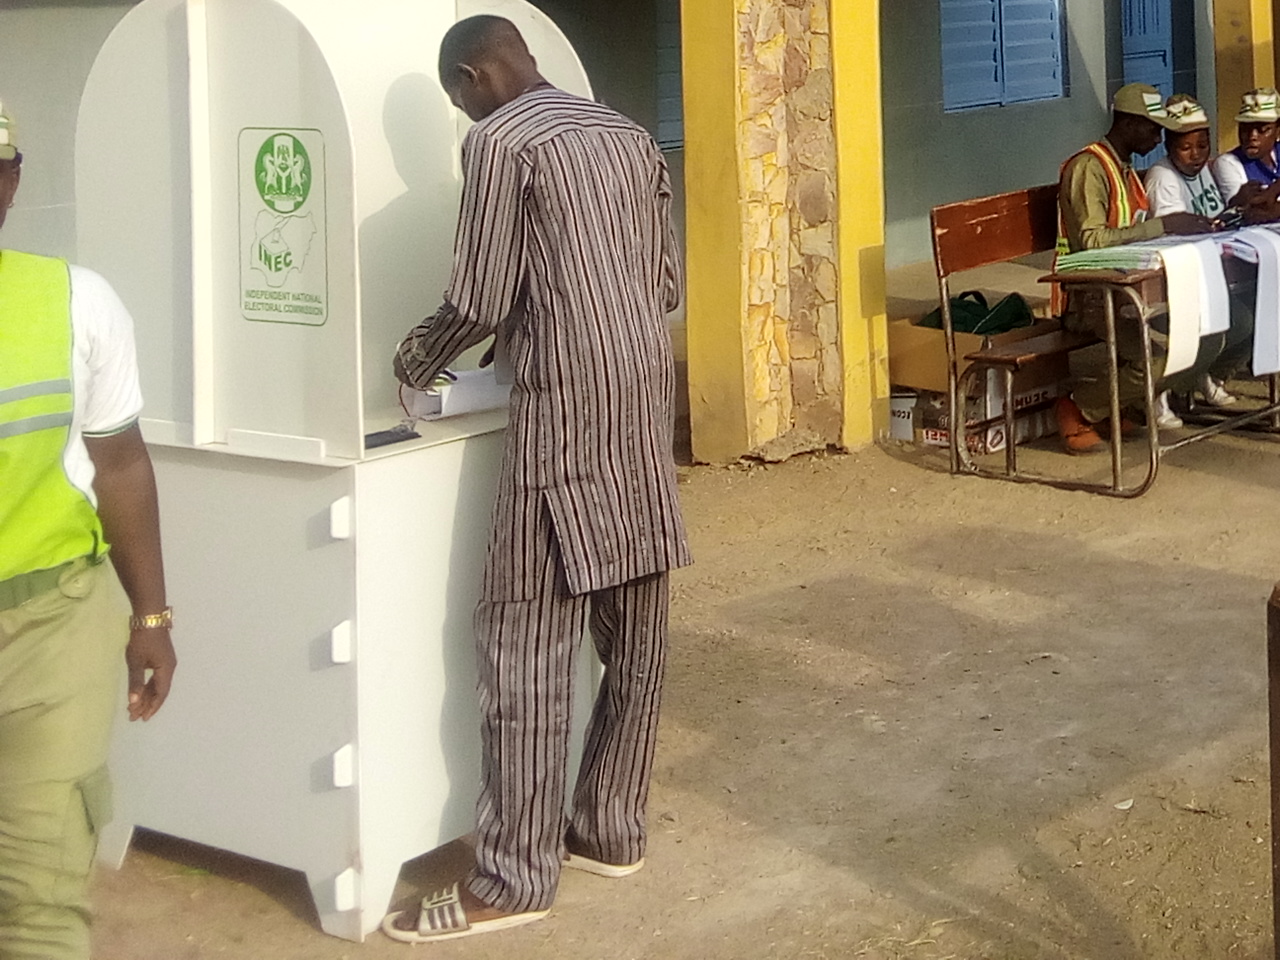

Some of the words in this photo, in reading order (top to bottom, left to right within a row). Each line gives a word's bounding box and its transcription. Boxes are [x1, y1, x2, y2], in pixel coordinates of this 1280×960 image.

[259, 243, 293, 272] INEC
[245, 290, 291, 301] INDEPENDENT
[292, 293, 322, 304] NATIONAL
[244, 301, 282, 312] ELECTORAL
